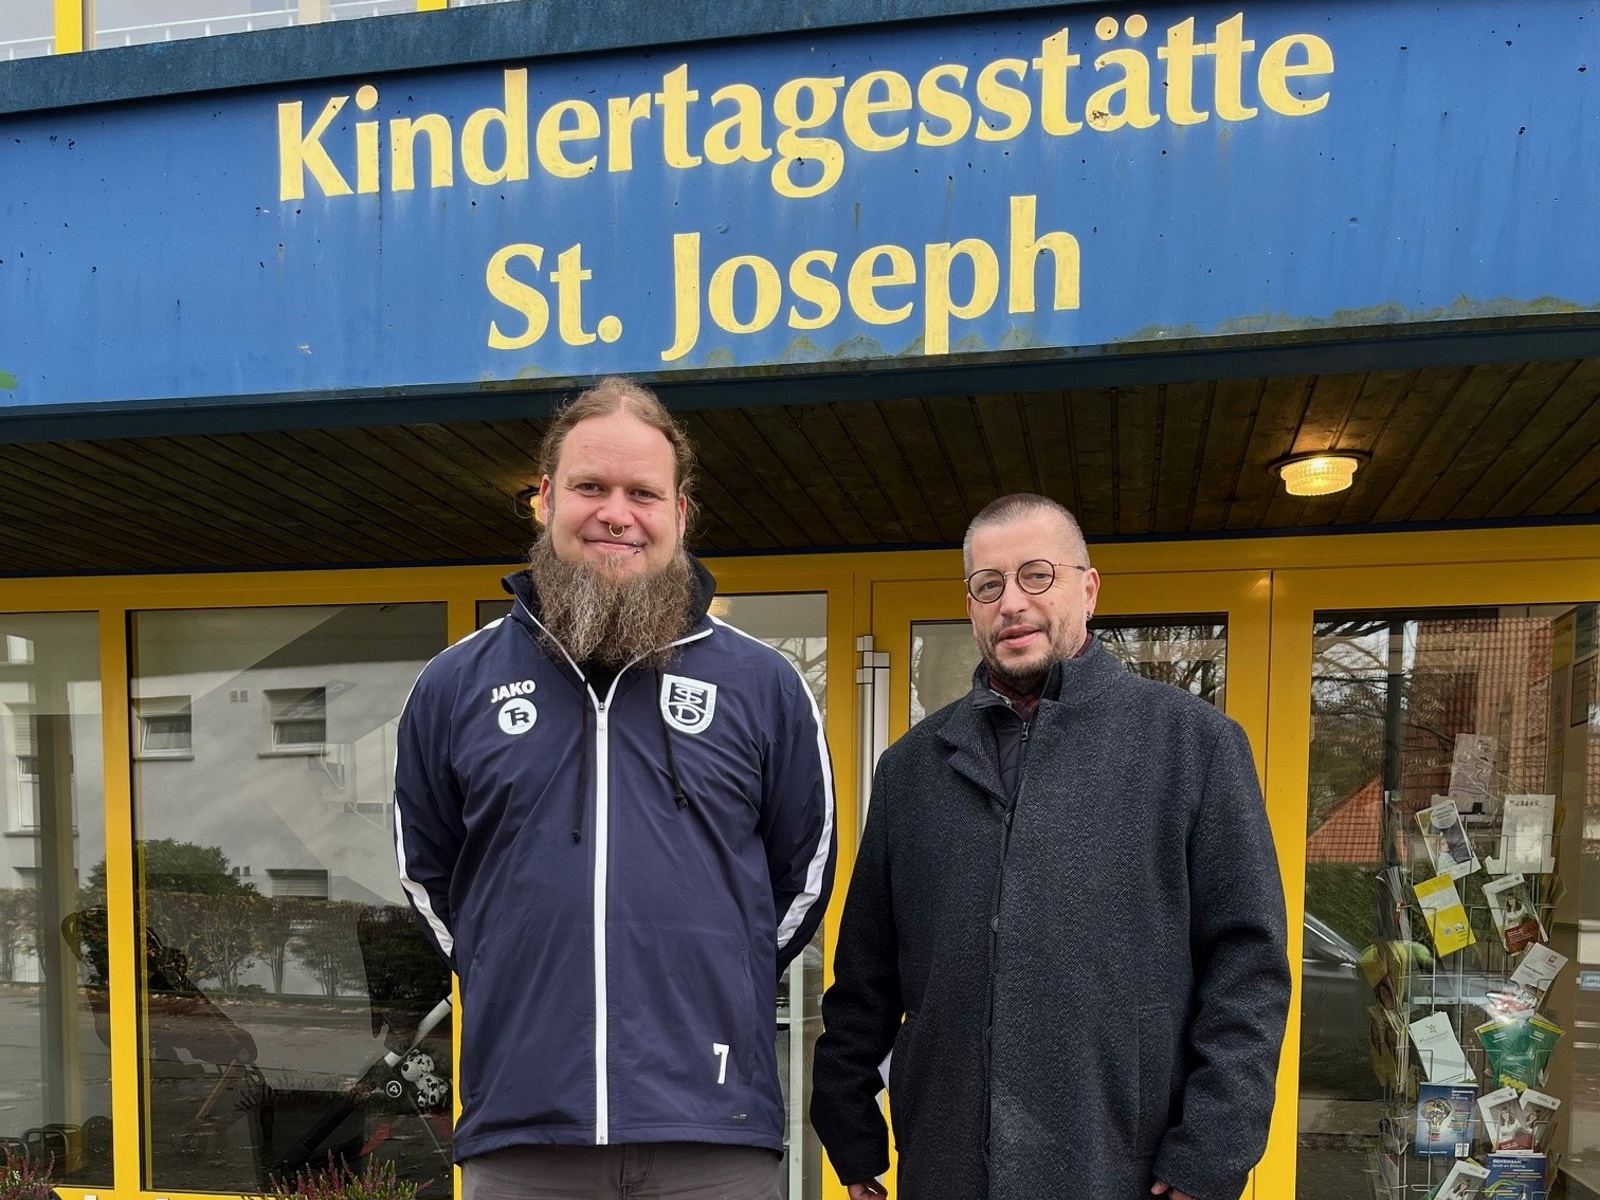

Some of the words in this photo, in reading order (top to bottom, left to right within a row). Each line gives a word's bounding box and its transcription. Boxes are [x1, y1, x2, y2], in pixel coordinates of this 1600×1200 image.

[278, 12, 1335, 201] Kindertagesstätte
[485, 242, 623, 351] St.
[660, 194, 1081, 362] Joseph
[491, 679, 536, 703] JAKO
[712, 1042, 730, 1084] 7
